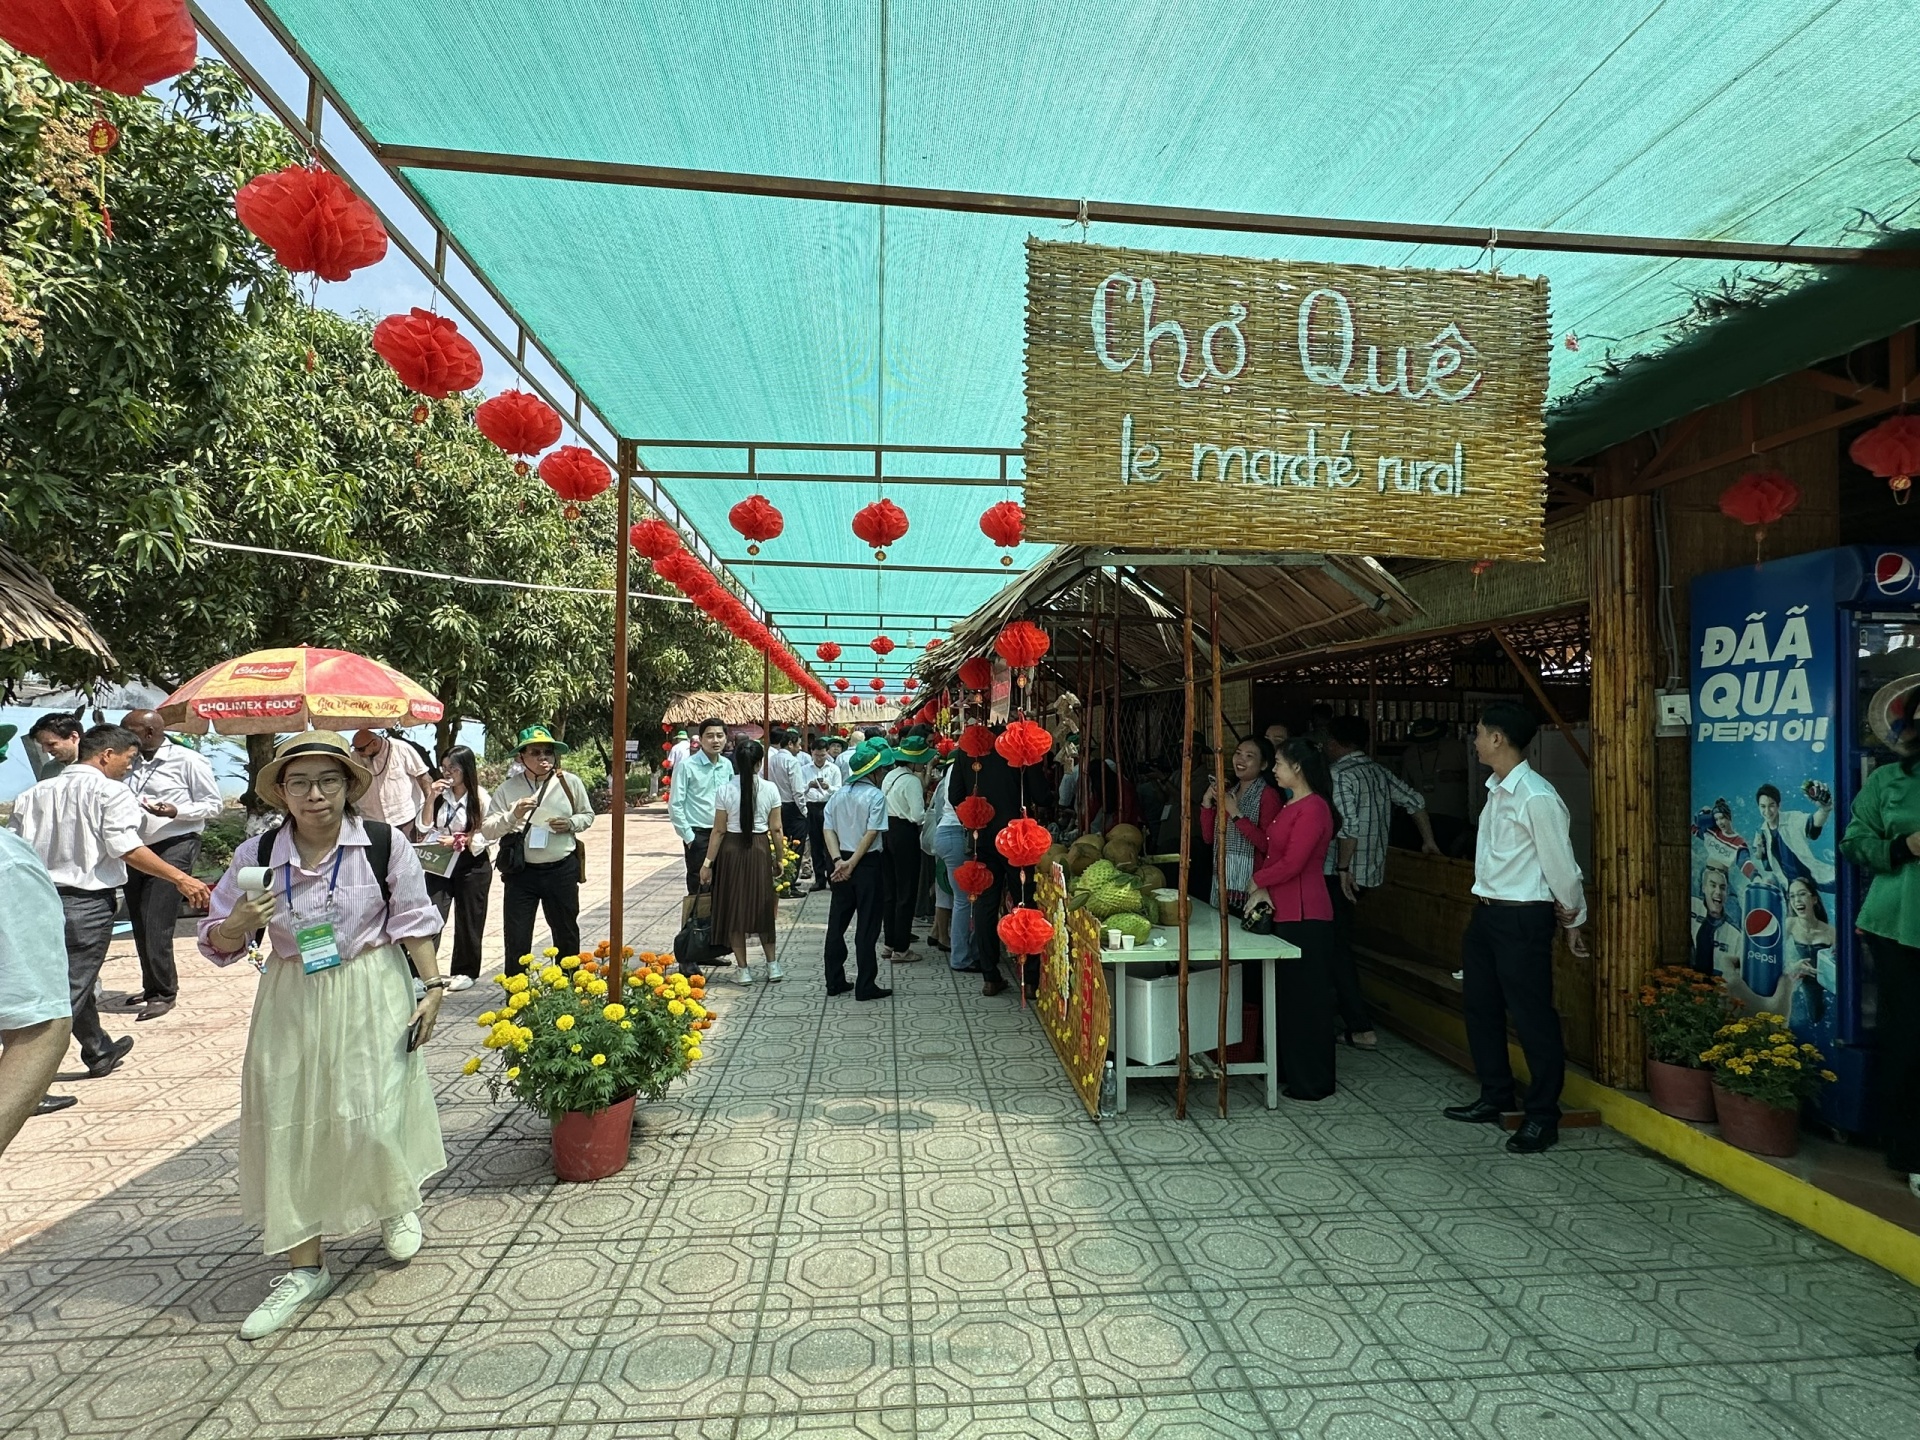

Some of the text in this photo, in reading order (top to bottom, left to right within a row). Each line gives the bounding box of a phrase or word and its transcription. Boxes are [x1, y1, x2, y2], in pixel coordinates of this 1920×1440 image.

[1091, 271, 1482, 401] Chợ Quê
[1121, 413, 1464, 499] le marché rural
[1700, 604, 1813, 668] ĐÃÃ
[234, 665, 292, 675] Cholimex
[1700, 659, 1813, 720] QUÁ
[198, 700, 297, 713] CHOLIMEX FOOD
[1697, 720, 1778, 742] PEPSI
[432, 853, 441, 863] 7
[1708, 839, 1731, 859] pepsi
[1747, 950, 1777, 965] pepsi
